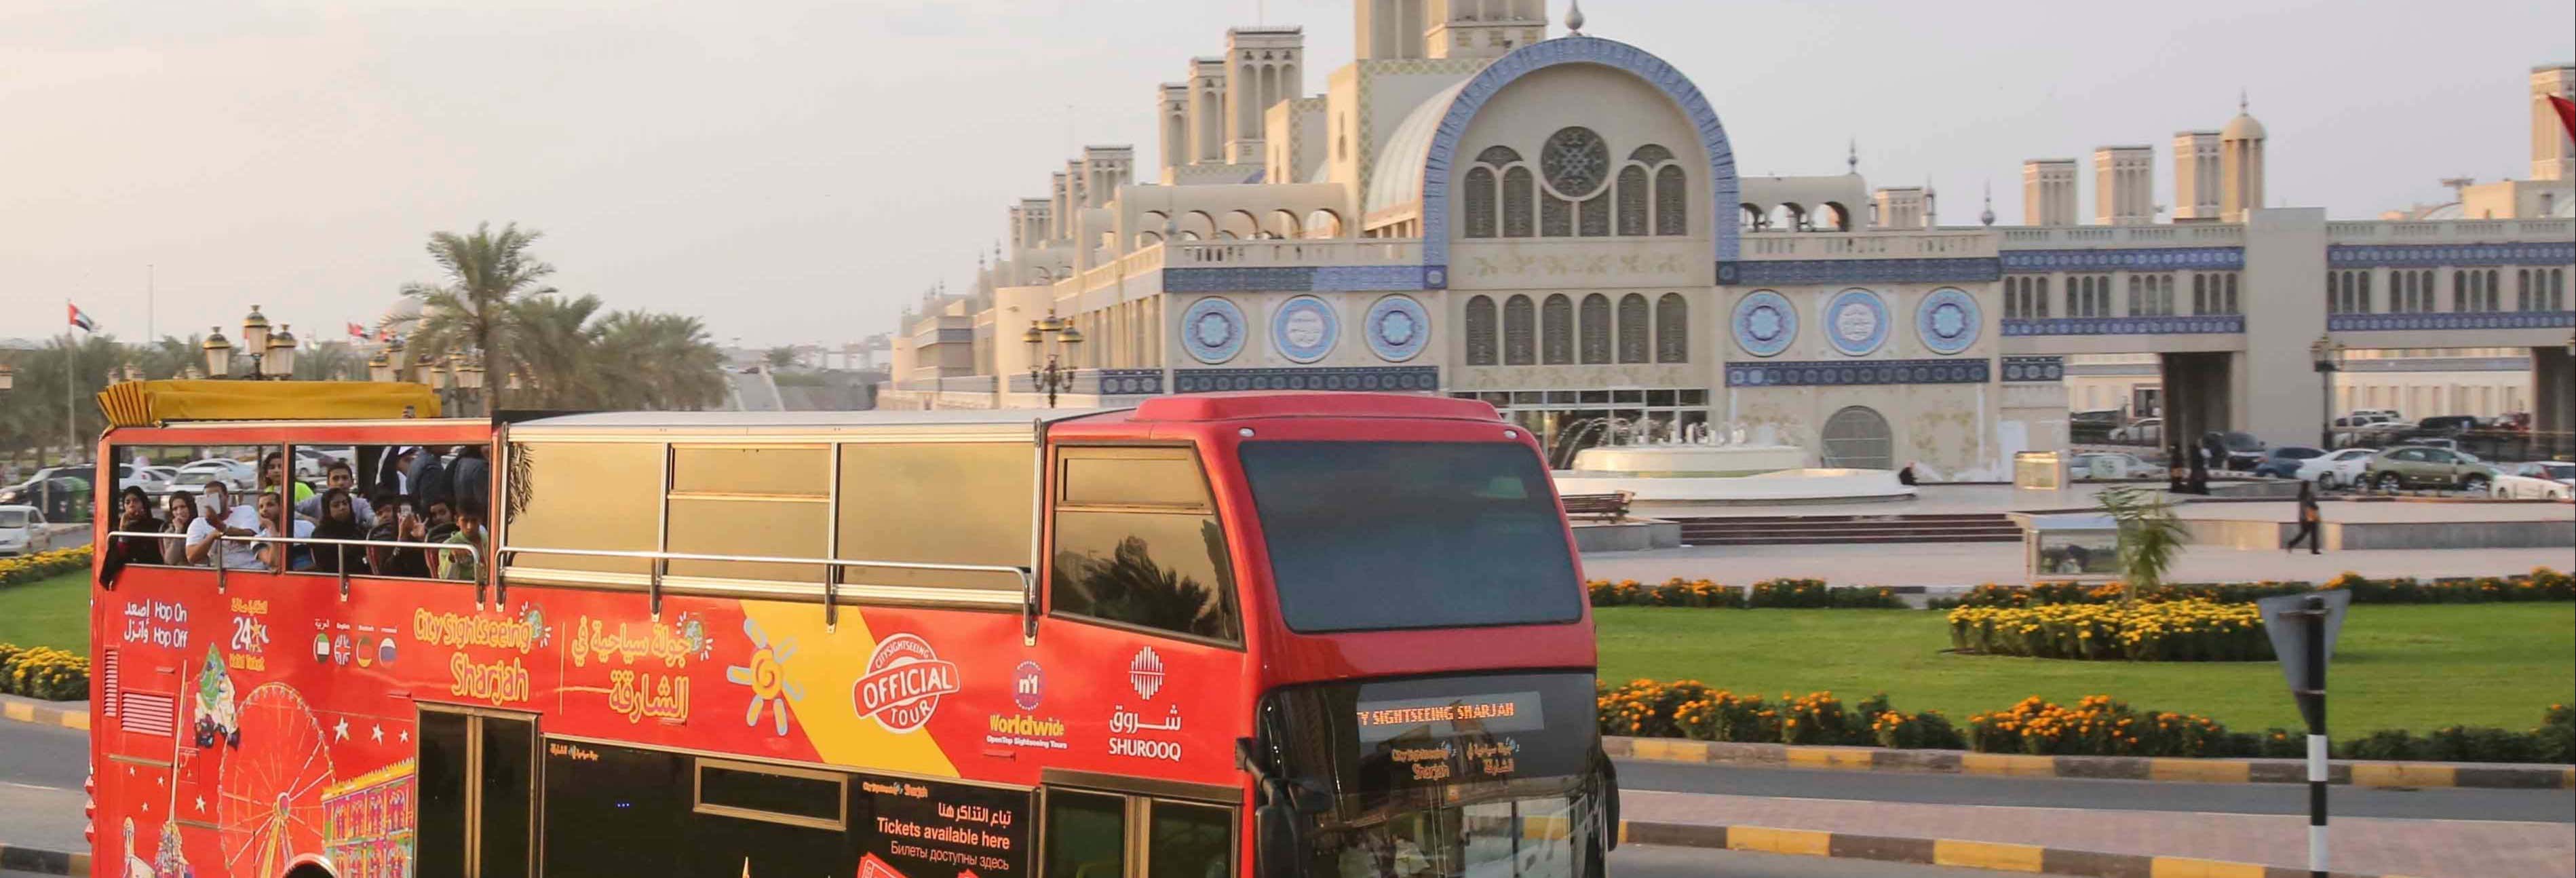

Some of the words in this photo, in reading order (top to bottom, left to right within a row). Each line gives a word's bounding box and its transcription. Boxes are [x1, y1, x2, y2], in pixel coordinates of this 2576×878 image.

[155, 602, 172, 623] Hop
[174, 603, 187, 623] On
[153, 626, 171, 648] Hop
[173, 628, 188, 648] Off
[231, 616, 252, 651] 24
[414, 607, 443, 645] City
[442, 612, 533, 655] Sightseeing
[571, 615, 589, 668] في
[590, 620, 649, 665] سياحية
[651, 623, 692, 668] جولة
[450, 651, 530, 706] Sharjah
[863, 666, 953, 709] OFFICIAL
[609, 669, 689, 724] الشارقة
[891, 700, 932, 727] TOUR
[990, 714, 1064, 737] Worldwide
[1372, 706, 1454, 725] SIGHTSEEING
[1457, 702, 1514, 719] SHARJAH
[1109, 737, 1182, 761] SHUROOQ
[938, 802, 955, 818] هنا
[955, 805, 988, 822] التذاكر
[991, 810, 1012, 828] تباع
[877, 817, 921, 837] Tickets
[923, 826, 978, 845] available
[982, 831, 1010, 850] here
[891, 841, 927, 859] Билеты
[929, 849, 978, 866] доступны
[979, 856, 1010, 871] здесь
